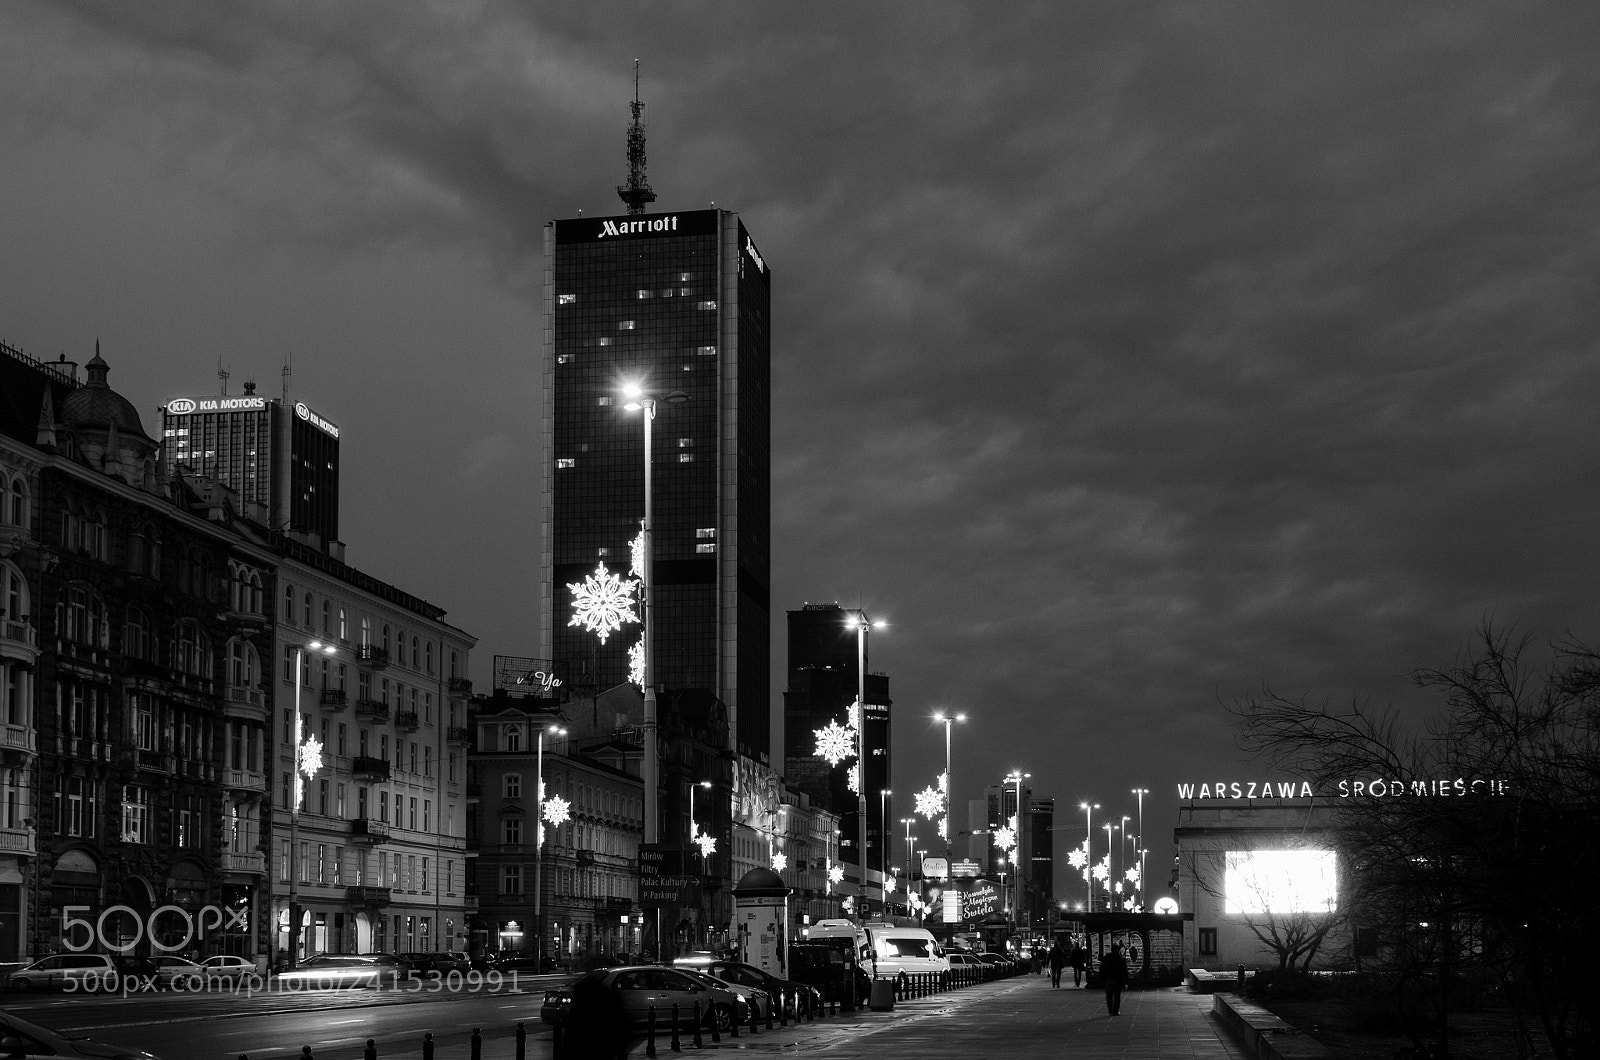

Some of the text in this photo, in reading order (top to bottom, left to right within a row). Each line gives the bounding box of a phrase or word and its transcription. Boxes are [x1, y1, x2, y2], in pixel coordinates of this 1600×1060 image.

[598, 216, 678, 238] Marriott
[200, 398, 264, 410] KIA MOTORS
[1177, 781, 1313, 799] WARSZAWA
[641, 865, 659, 876] Filtry
[660, 877, 688, 889] Kultury
[650, 891, 677, 902] Parking
[861, 903, 869, 914] P
[970, 923, 976, 932] P
